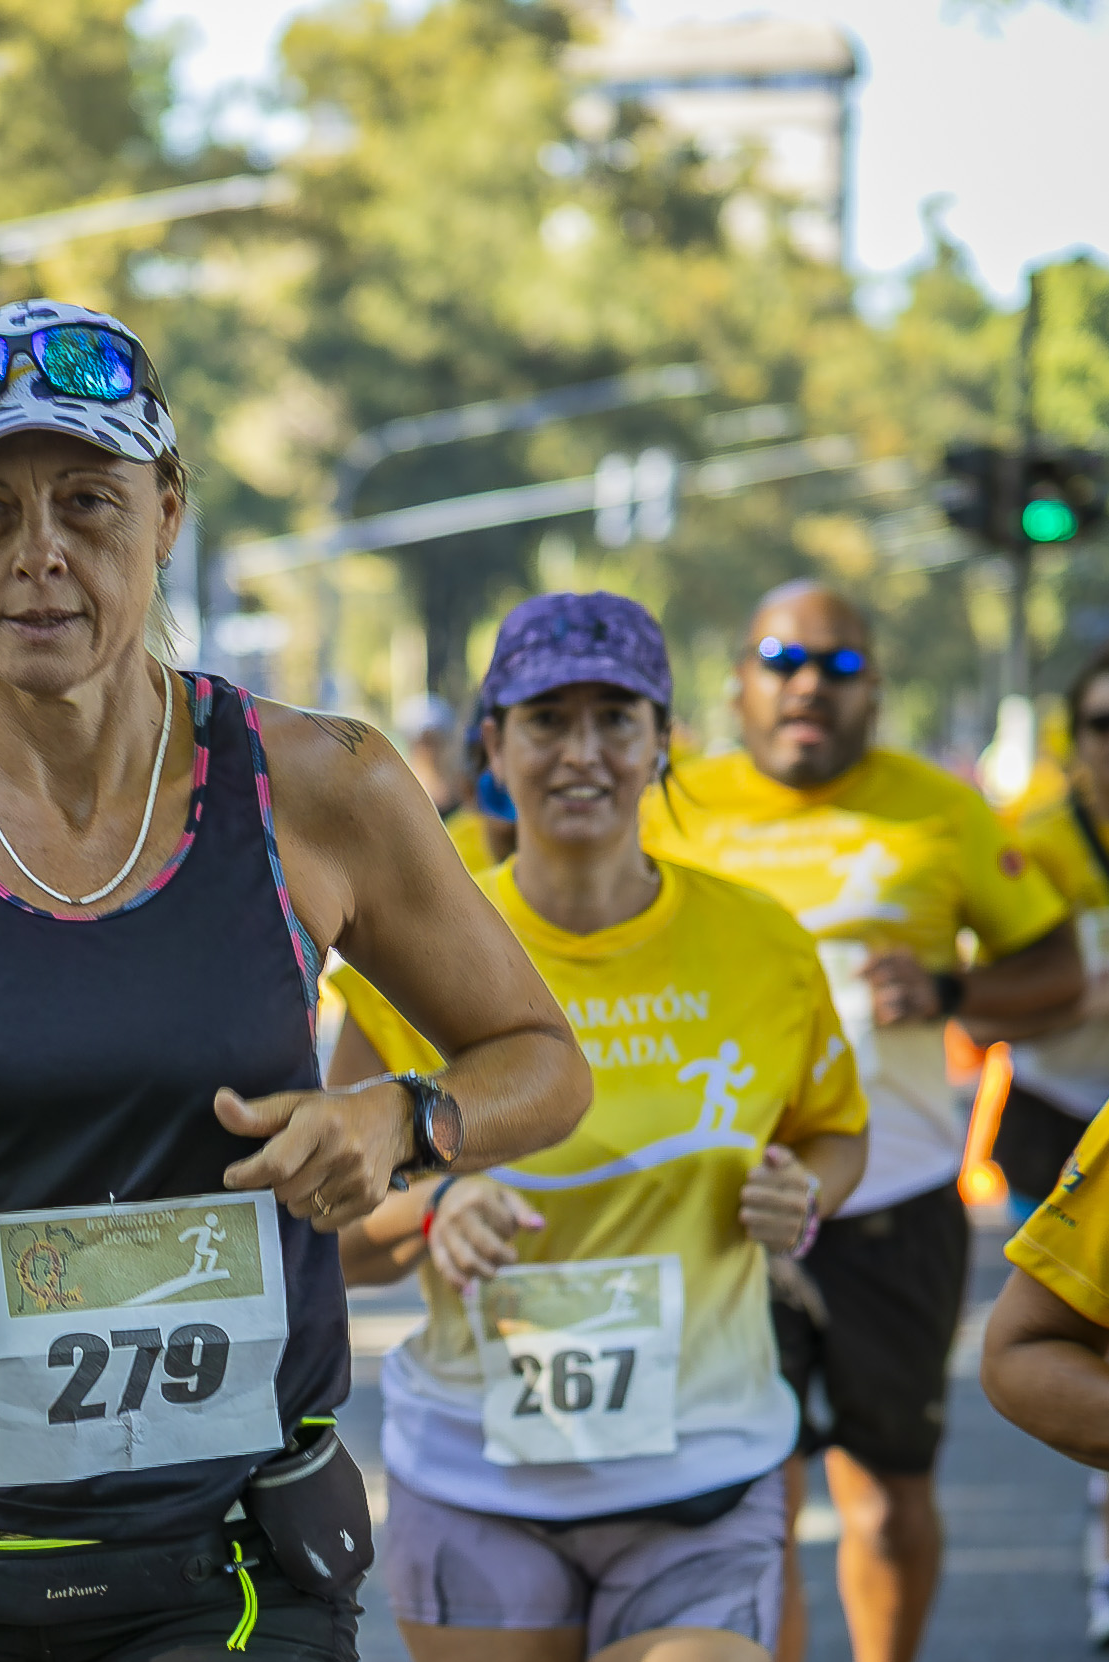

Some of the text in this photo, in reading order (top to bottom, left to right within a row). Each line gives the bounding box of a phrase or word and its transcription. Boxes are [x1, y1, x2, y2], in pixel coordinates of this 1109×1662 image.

[565, 982, 710, 1029] ARATÓN
[48, 1323, 230, 1426] 279
[510, 1347, 637, 1418] 267
